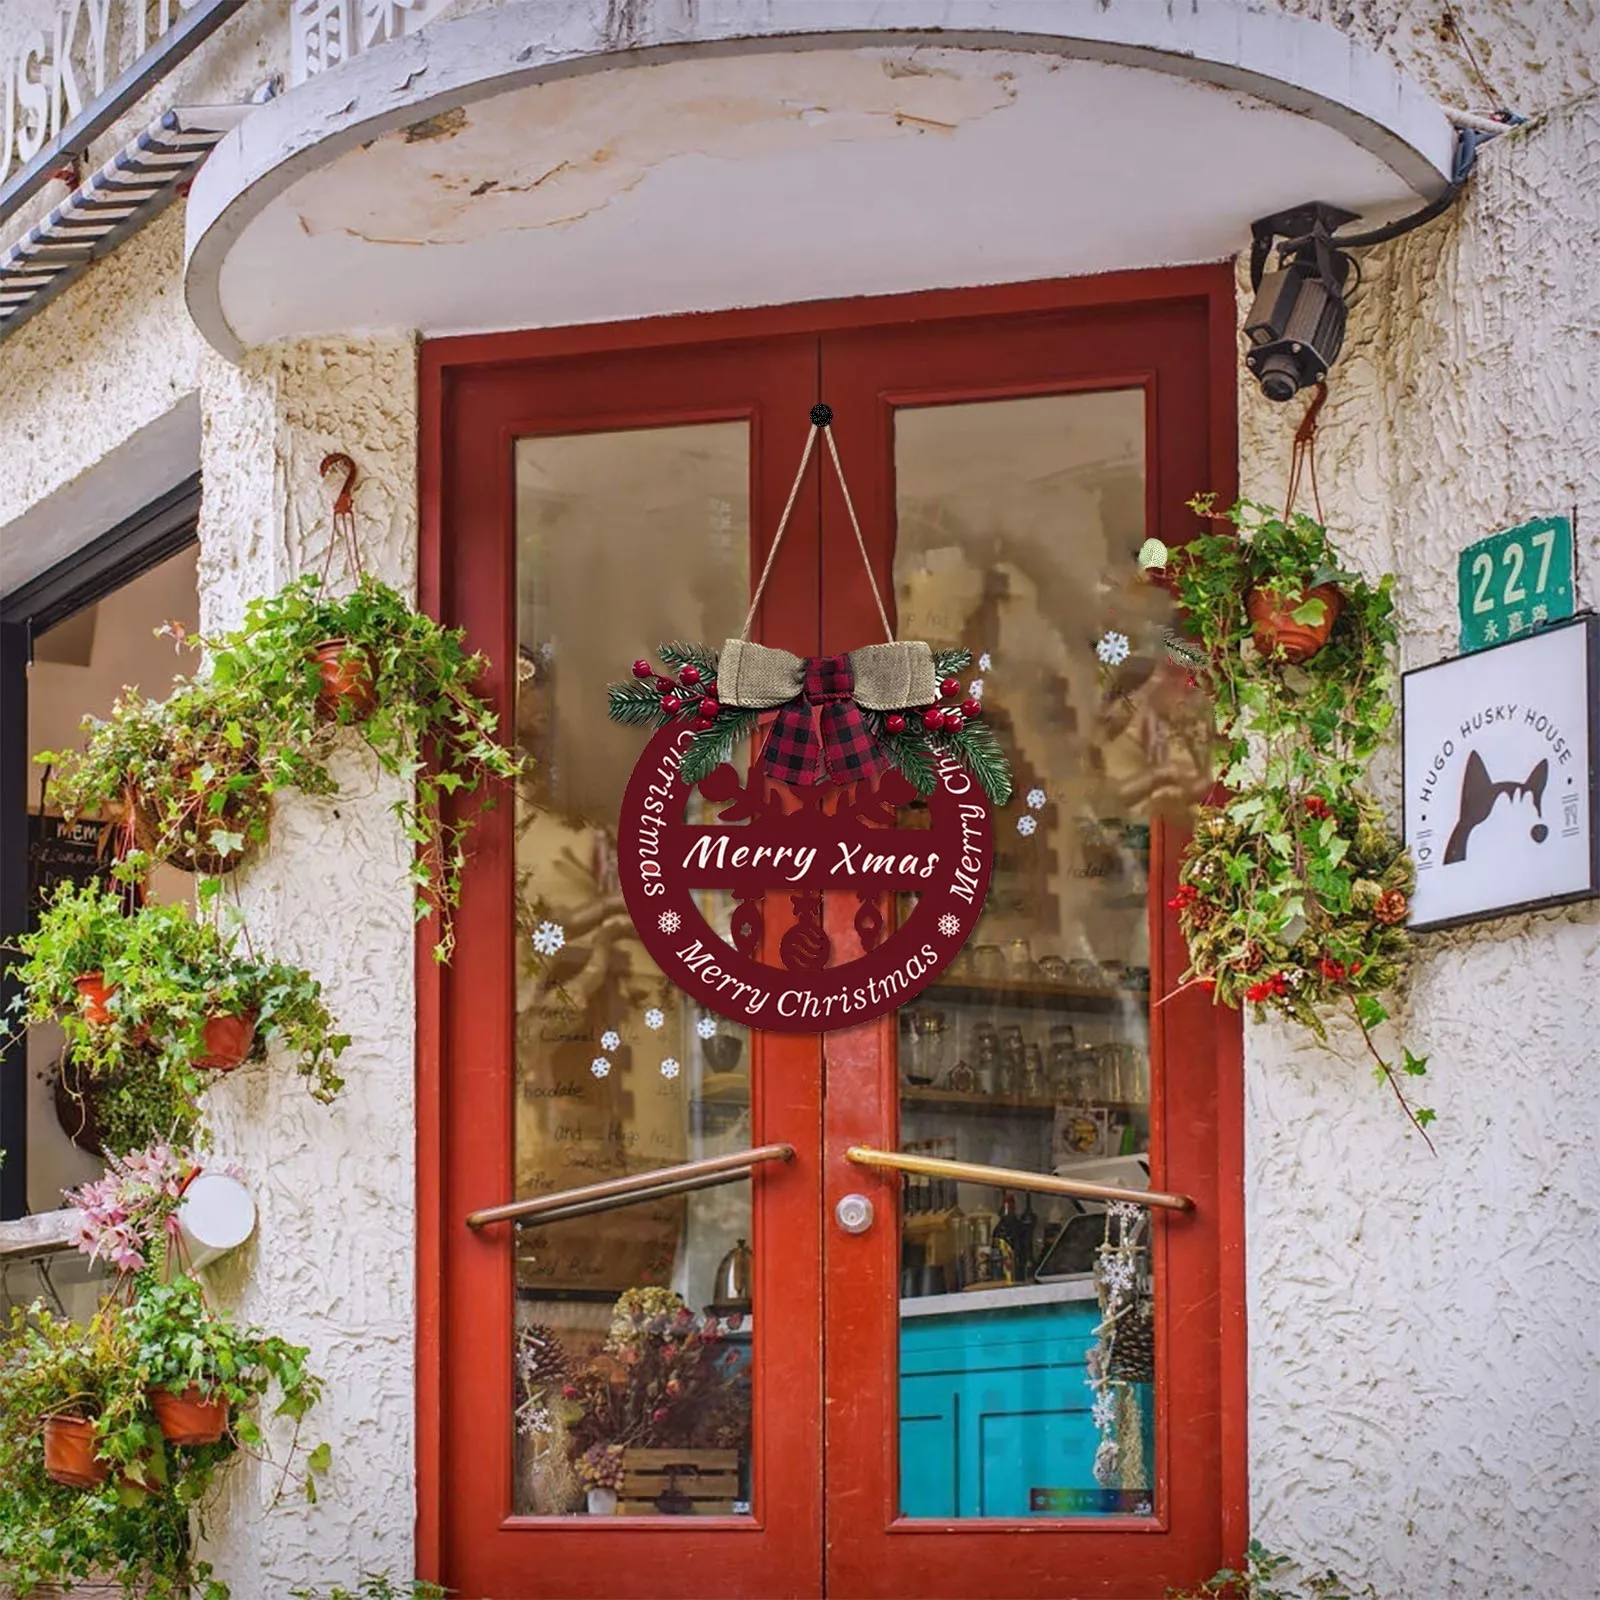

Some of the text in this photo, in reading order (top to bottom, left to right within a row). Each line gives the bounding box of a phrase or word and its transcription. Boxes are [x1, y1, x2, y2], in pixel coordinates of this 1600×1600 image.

[1420, 704, 1572, 802] HUGO HUSKY HOUSE
[682, 835, 940, 881] Merry Xmas
[950, 804, 986, 905] Merry
[675, 939, 939, 1018] Merry Christmas
